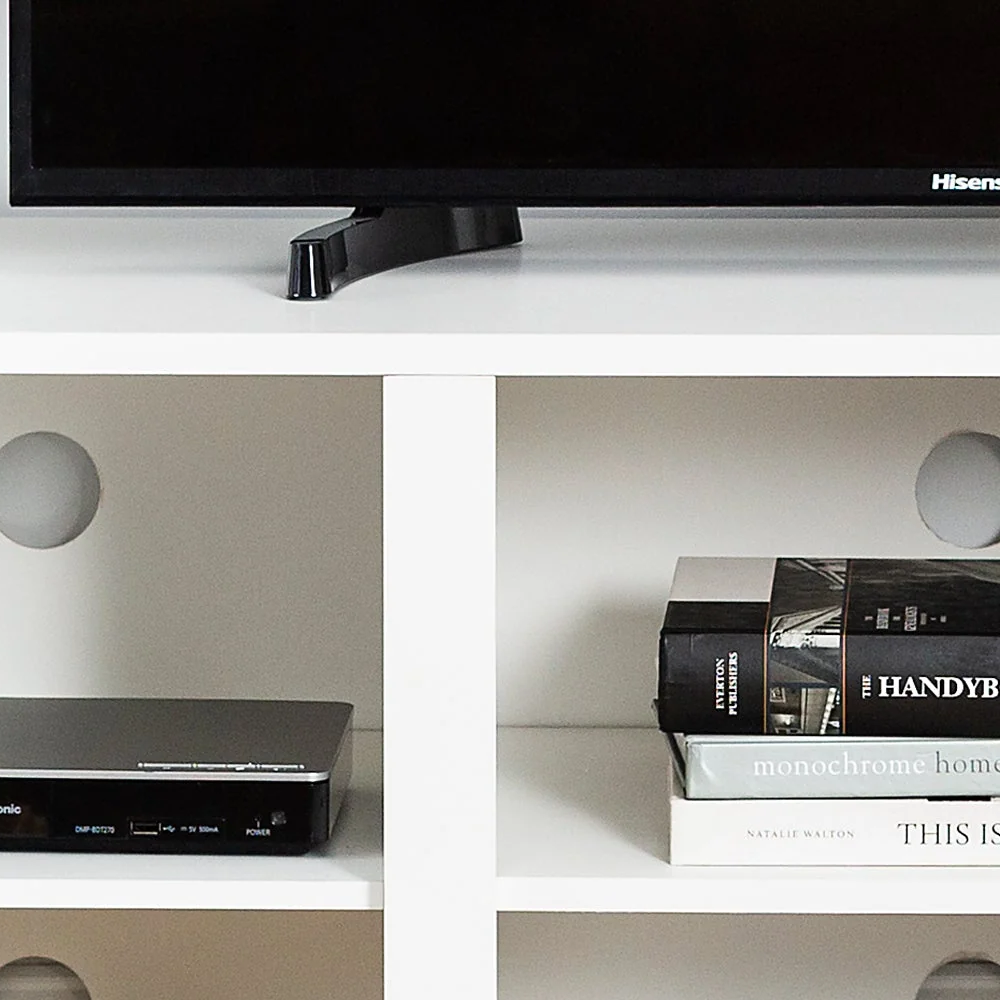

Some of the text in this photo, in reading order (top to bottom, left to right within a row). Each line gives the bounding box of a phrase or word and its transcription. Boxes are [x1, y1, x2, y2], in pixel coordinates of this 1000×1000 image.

[728, 651, 738, 715] PUBLISHERS
[862, 674, 872, 699] THE
[753, 751, 926, 776] monochrome
[747, 829, 855, 839] NATALIE WALTON
[898, 822, 970, 846] THIS
